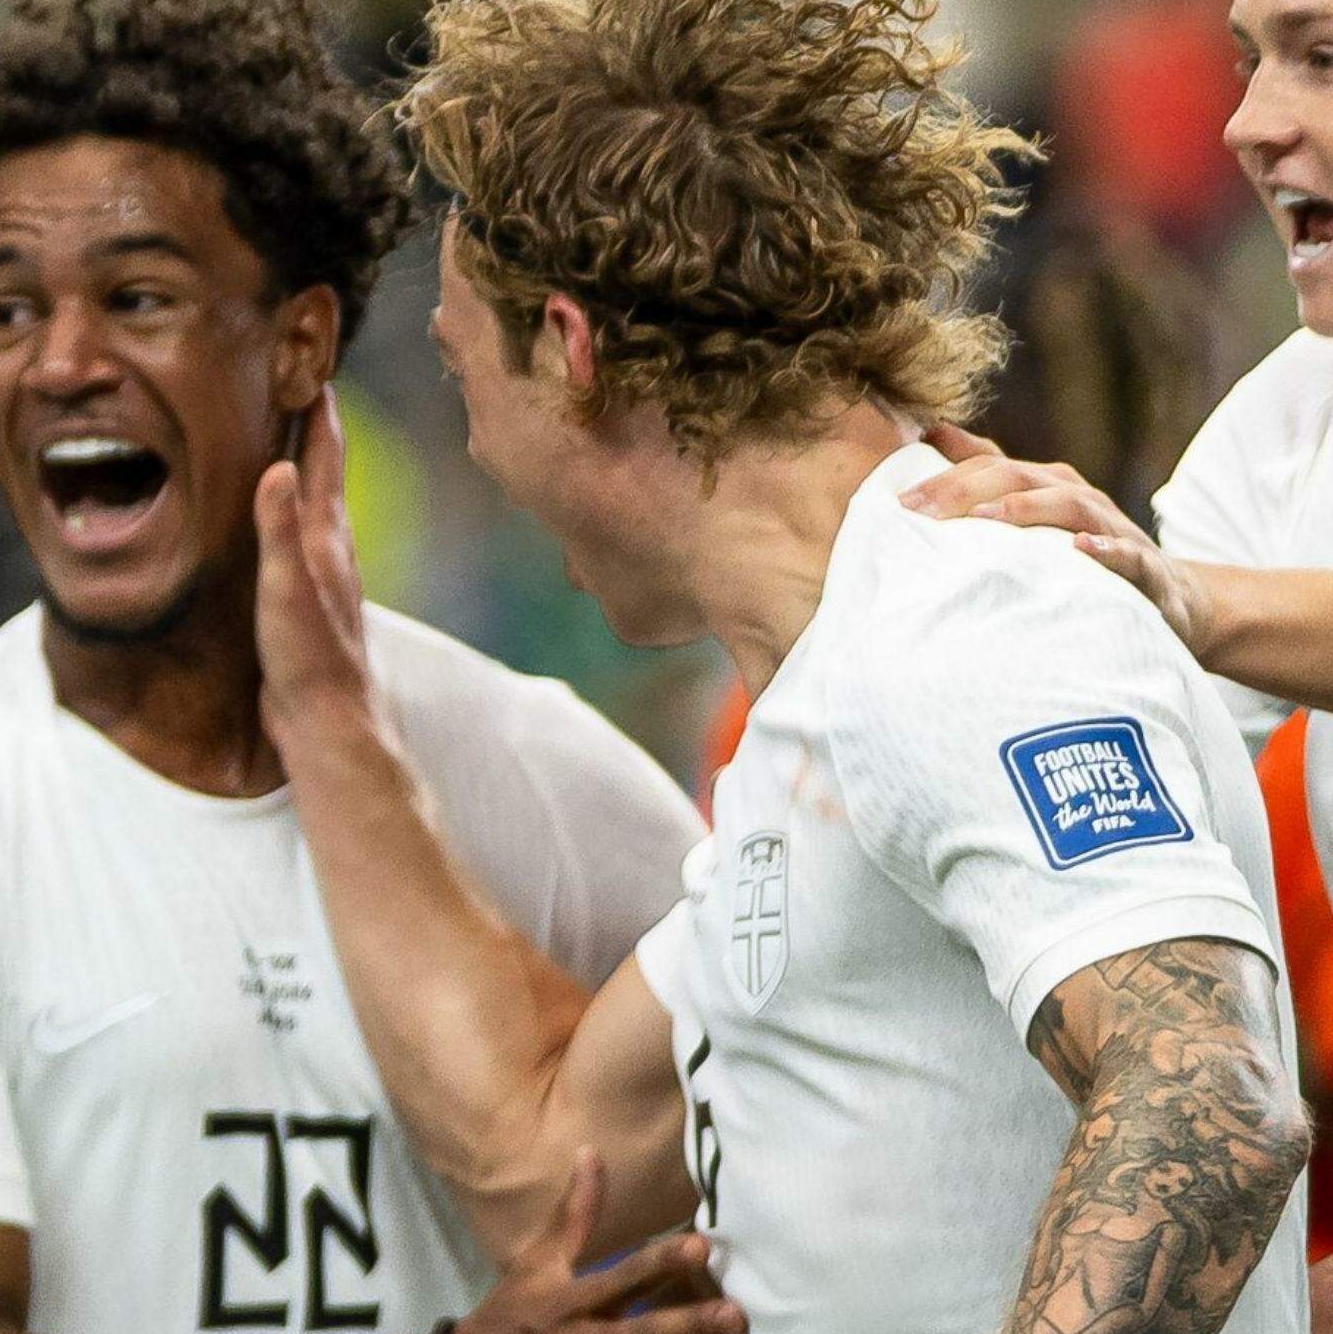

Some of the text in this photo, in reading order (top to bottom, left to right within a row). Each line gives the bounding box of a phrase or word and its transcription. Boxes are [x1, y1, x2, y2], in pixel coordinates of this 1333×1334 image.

[1034, 741, 1128, 776] FOOTBALL
[1043, 761, 1140, 805] UNITES
[1053, 791, 1156, 830] the World
[1092, 815, 1136, 833] FIFA
[197, 1110, 380, 1331] 22
